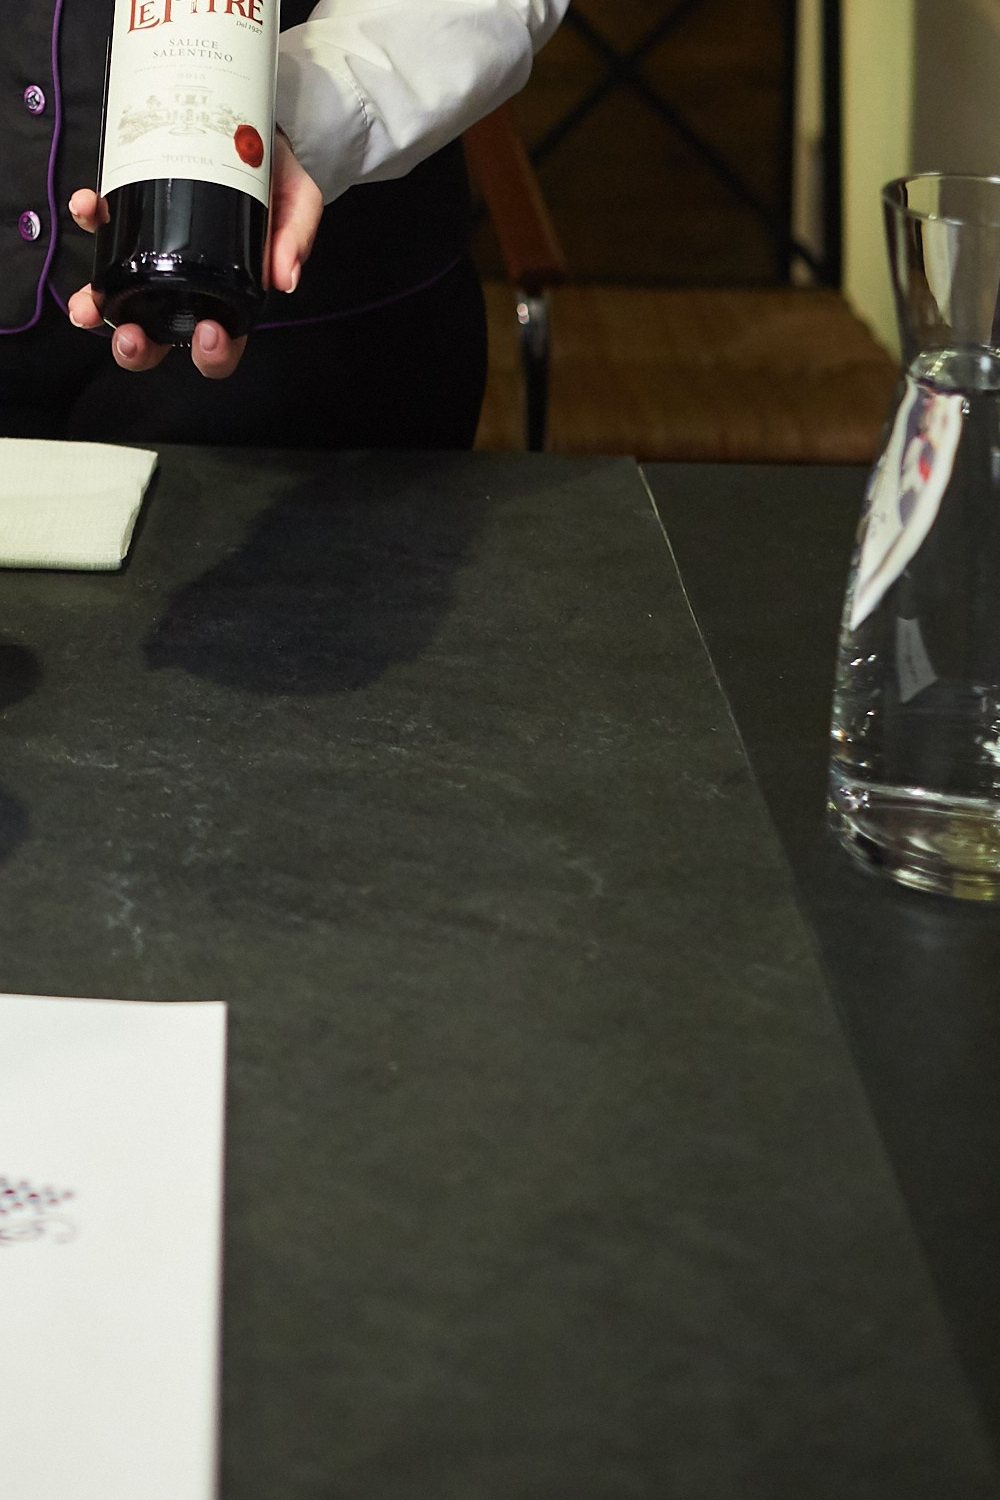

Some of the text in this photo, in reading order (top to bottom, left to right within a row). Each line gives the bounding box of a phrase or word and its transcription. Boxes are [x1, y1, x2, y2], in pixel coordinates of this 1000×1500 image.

[248, 24, 263, 35] 1927
[169, 38, 219, 50] SALICE
[152, 49, 233, 63] SALENTINO
